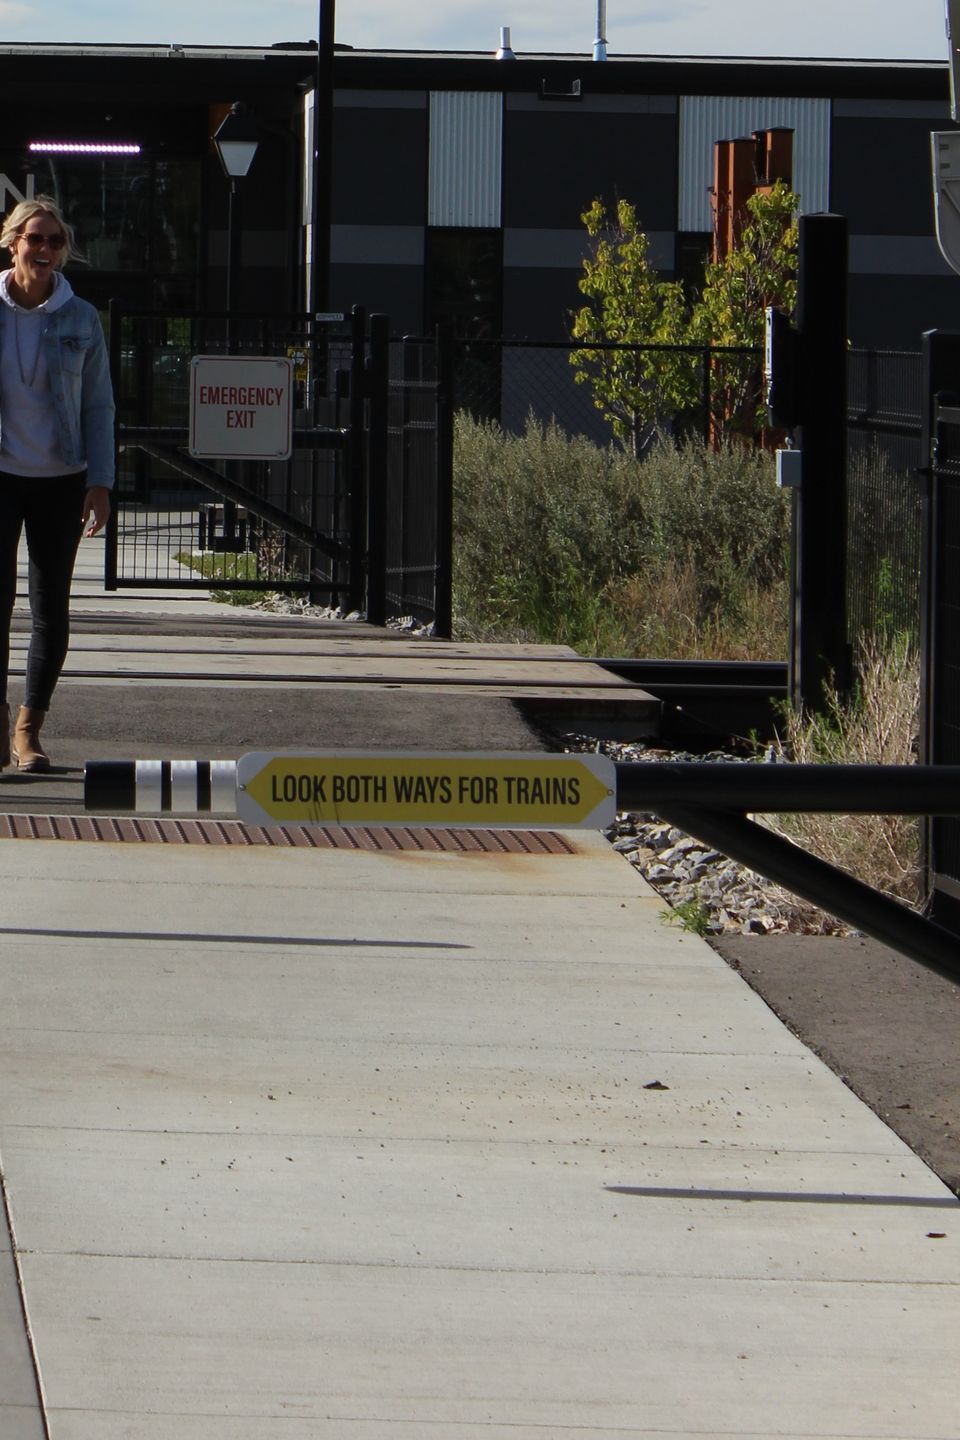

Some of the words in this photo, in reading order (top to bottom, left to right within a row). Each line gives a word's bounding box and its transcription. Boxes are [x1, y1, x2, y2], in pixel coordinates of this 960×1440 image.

[200, 385, 284, 406] EMERGENCY
[226, 410, 256, 428] EXIT
[271, 775, 327, 803] LOOK
[333, 775, 387, 803] BOTH
[393, 775, 452, 804] WAYS
[458, 776, 498, 805] FOR
[503, 777, 580, 806] TRAINS
